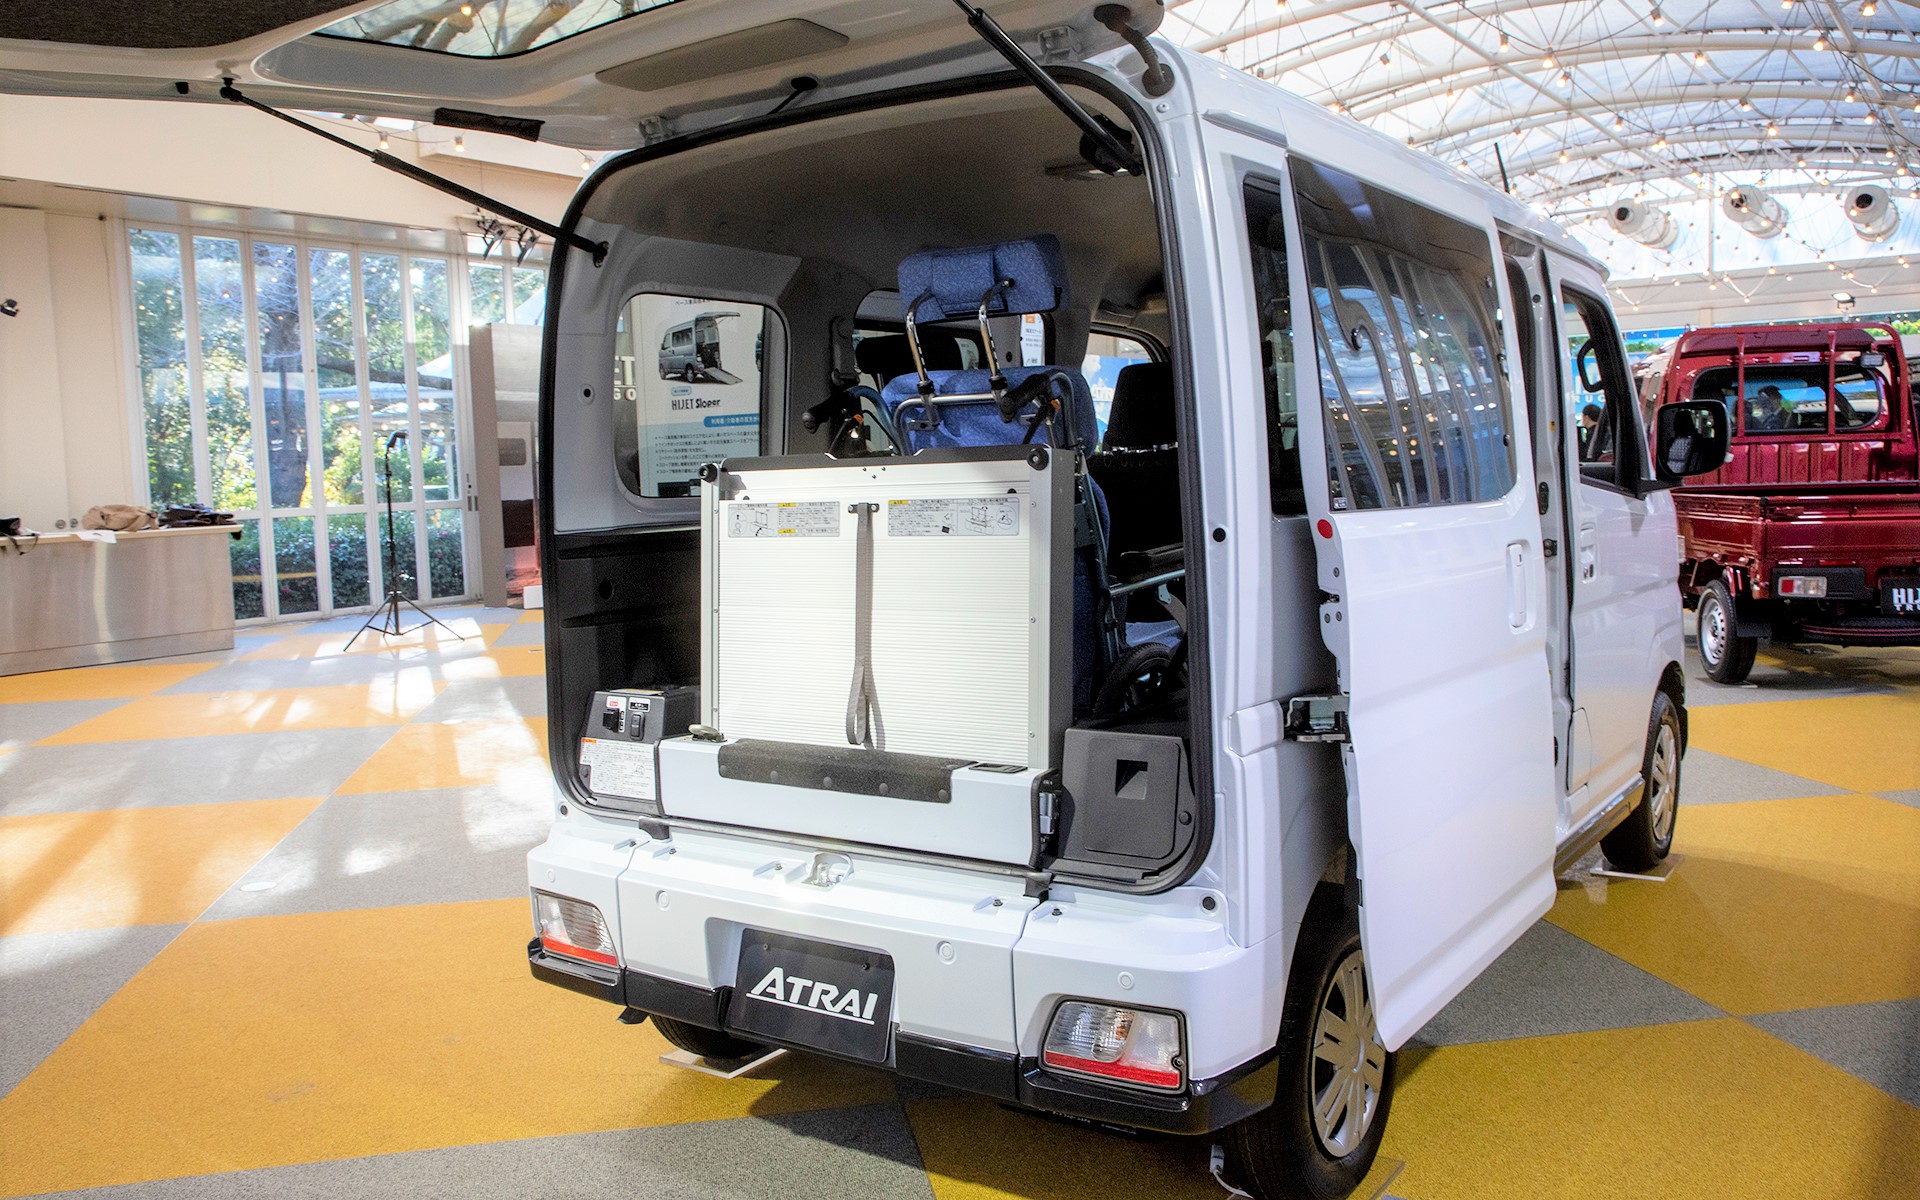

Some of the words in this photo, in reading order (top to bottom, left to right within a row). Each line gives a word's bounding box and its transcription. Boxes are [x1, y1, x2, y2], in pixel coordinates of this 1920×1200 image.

[671, 399, 694, 411] HIJET
[695, 398, 721, 409] Sloper
[750, 966, 879, 1020] ATRAI
